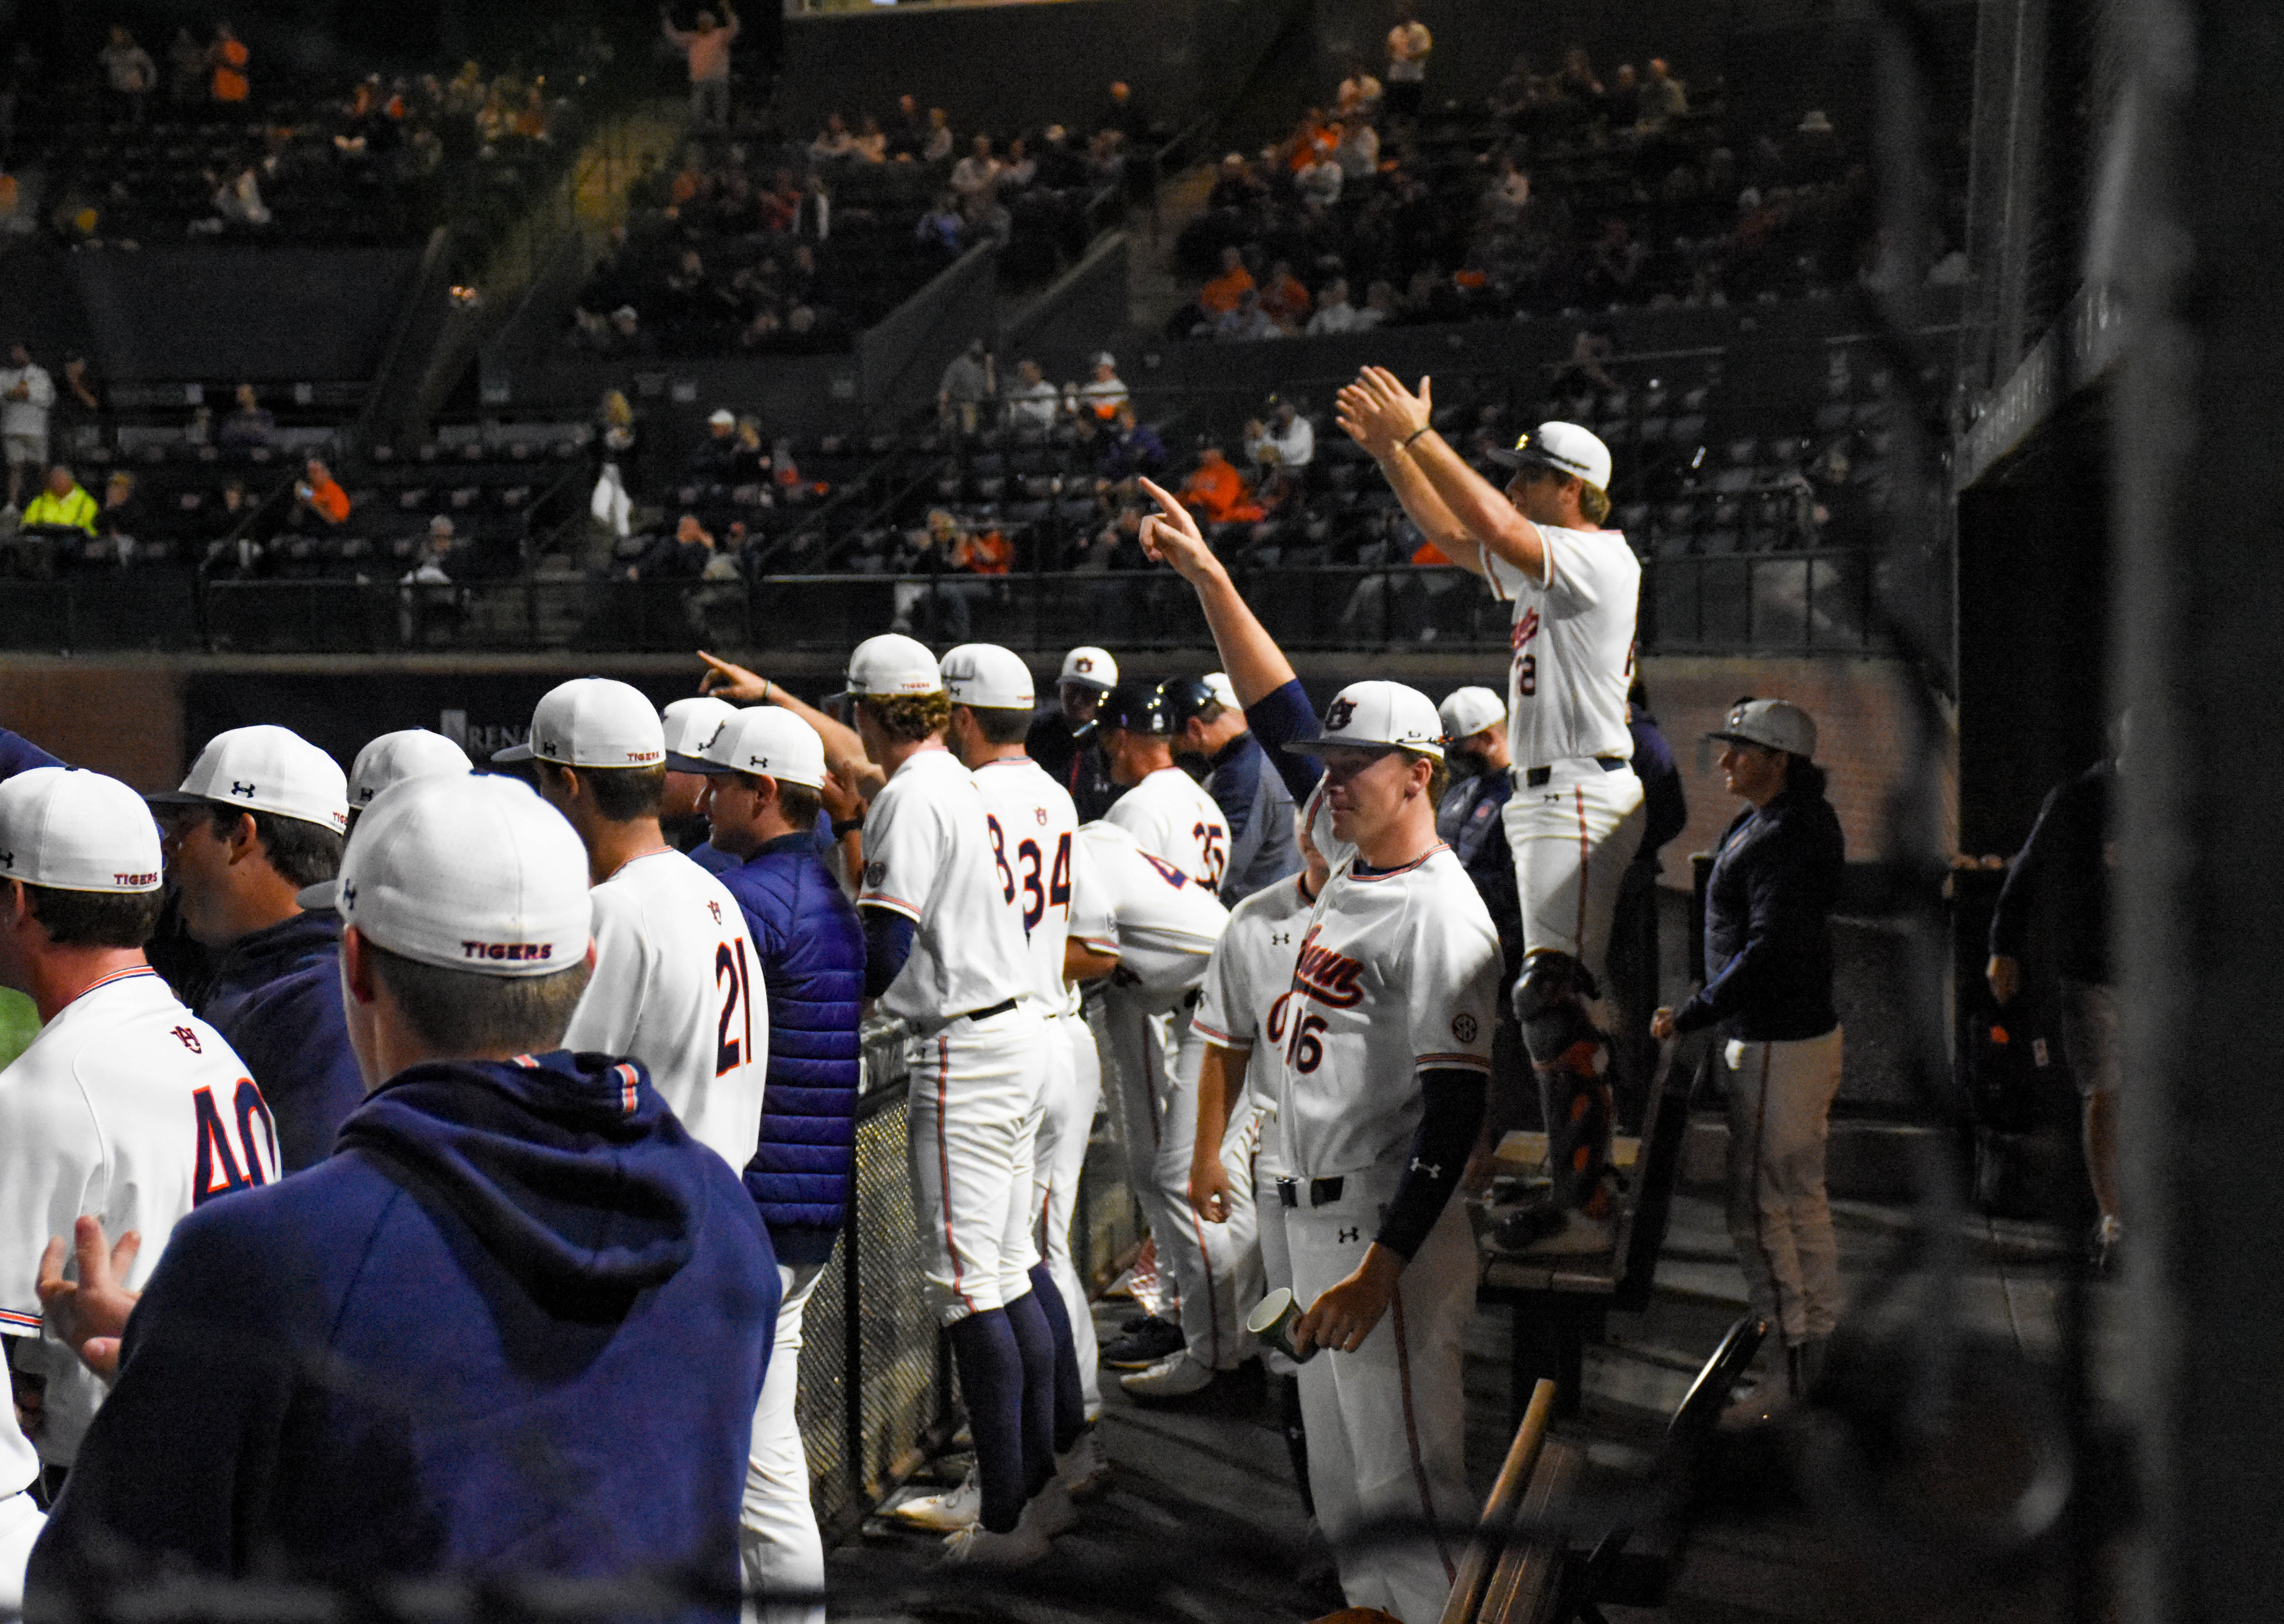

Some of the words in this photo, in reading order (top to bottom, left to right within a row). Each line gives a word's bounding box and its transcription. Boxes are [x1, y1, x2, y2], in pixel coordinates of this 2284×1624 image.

[627, 751, 659, 761] TIGERS
[114, 872, 158, 885] TIGERS
[1018, 831, 1072, 930] 34
[461, 941, 553, 960] TIGERS
[715, 936, 752, 1078] 21
[1285, 1007, 1328, 1074] 16
[192, 1077, 277, 1208] 40
